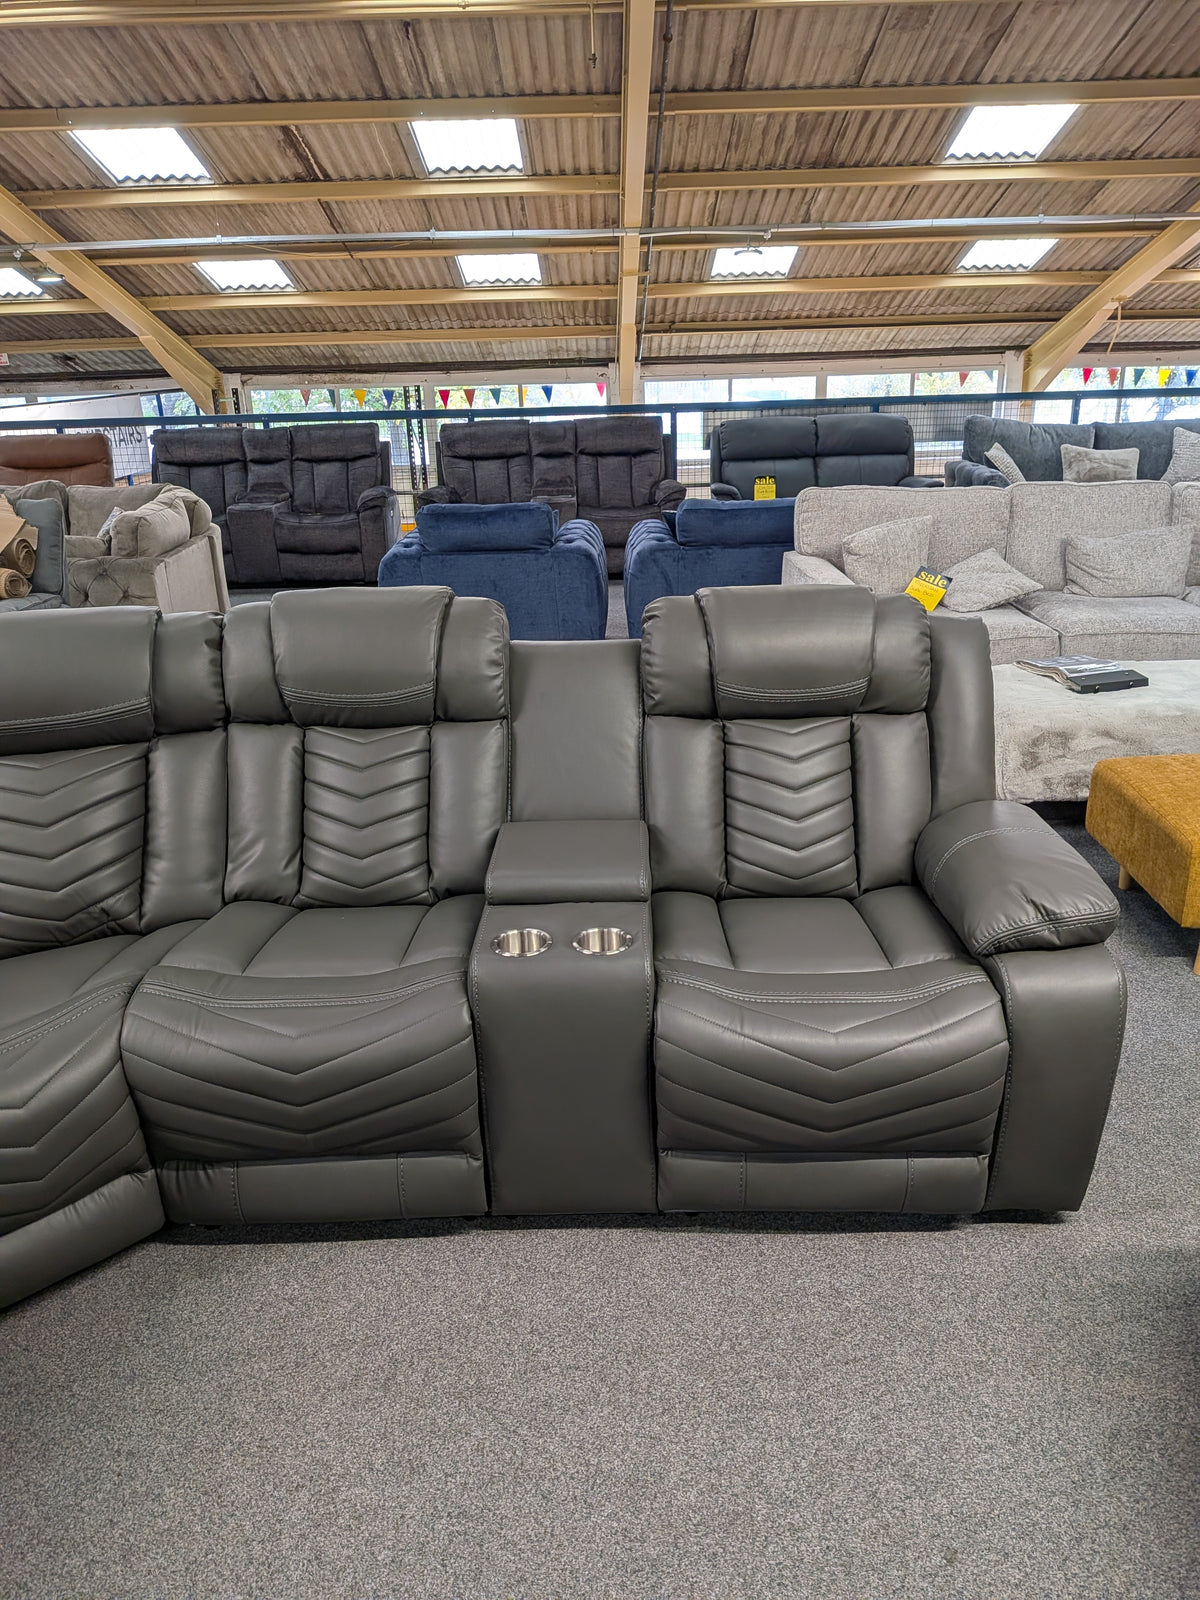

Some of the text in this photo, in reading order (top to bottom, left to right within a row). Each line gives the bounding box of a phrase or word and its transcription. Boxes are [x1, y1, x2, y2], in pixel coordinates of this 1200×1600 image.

[86, 426, 142, 448] STAIRS
[755, 476, 775, 485] sale
[919, 571, 947, 587] sale
